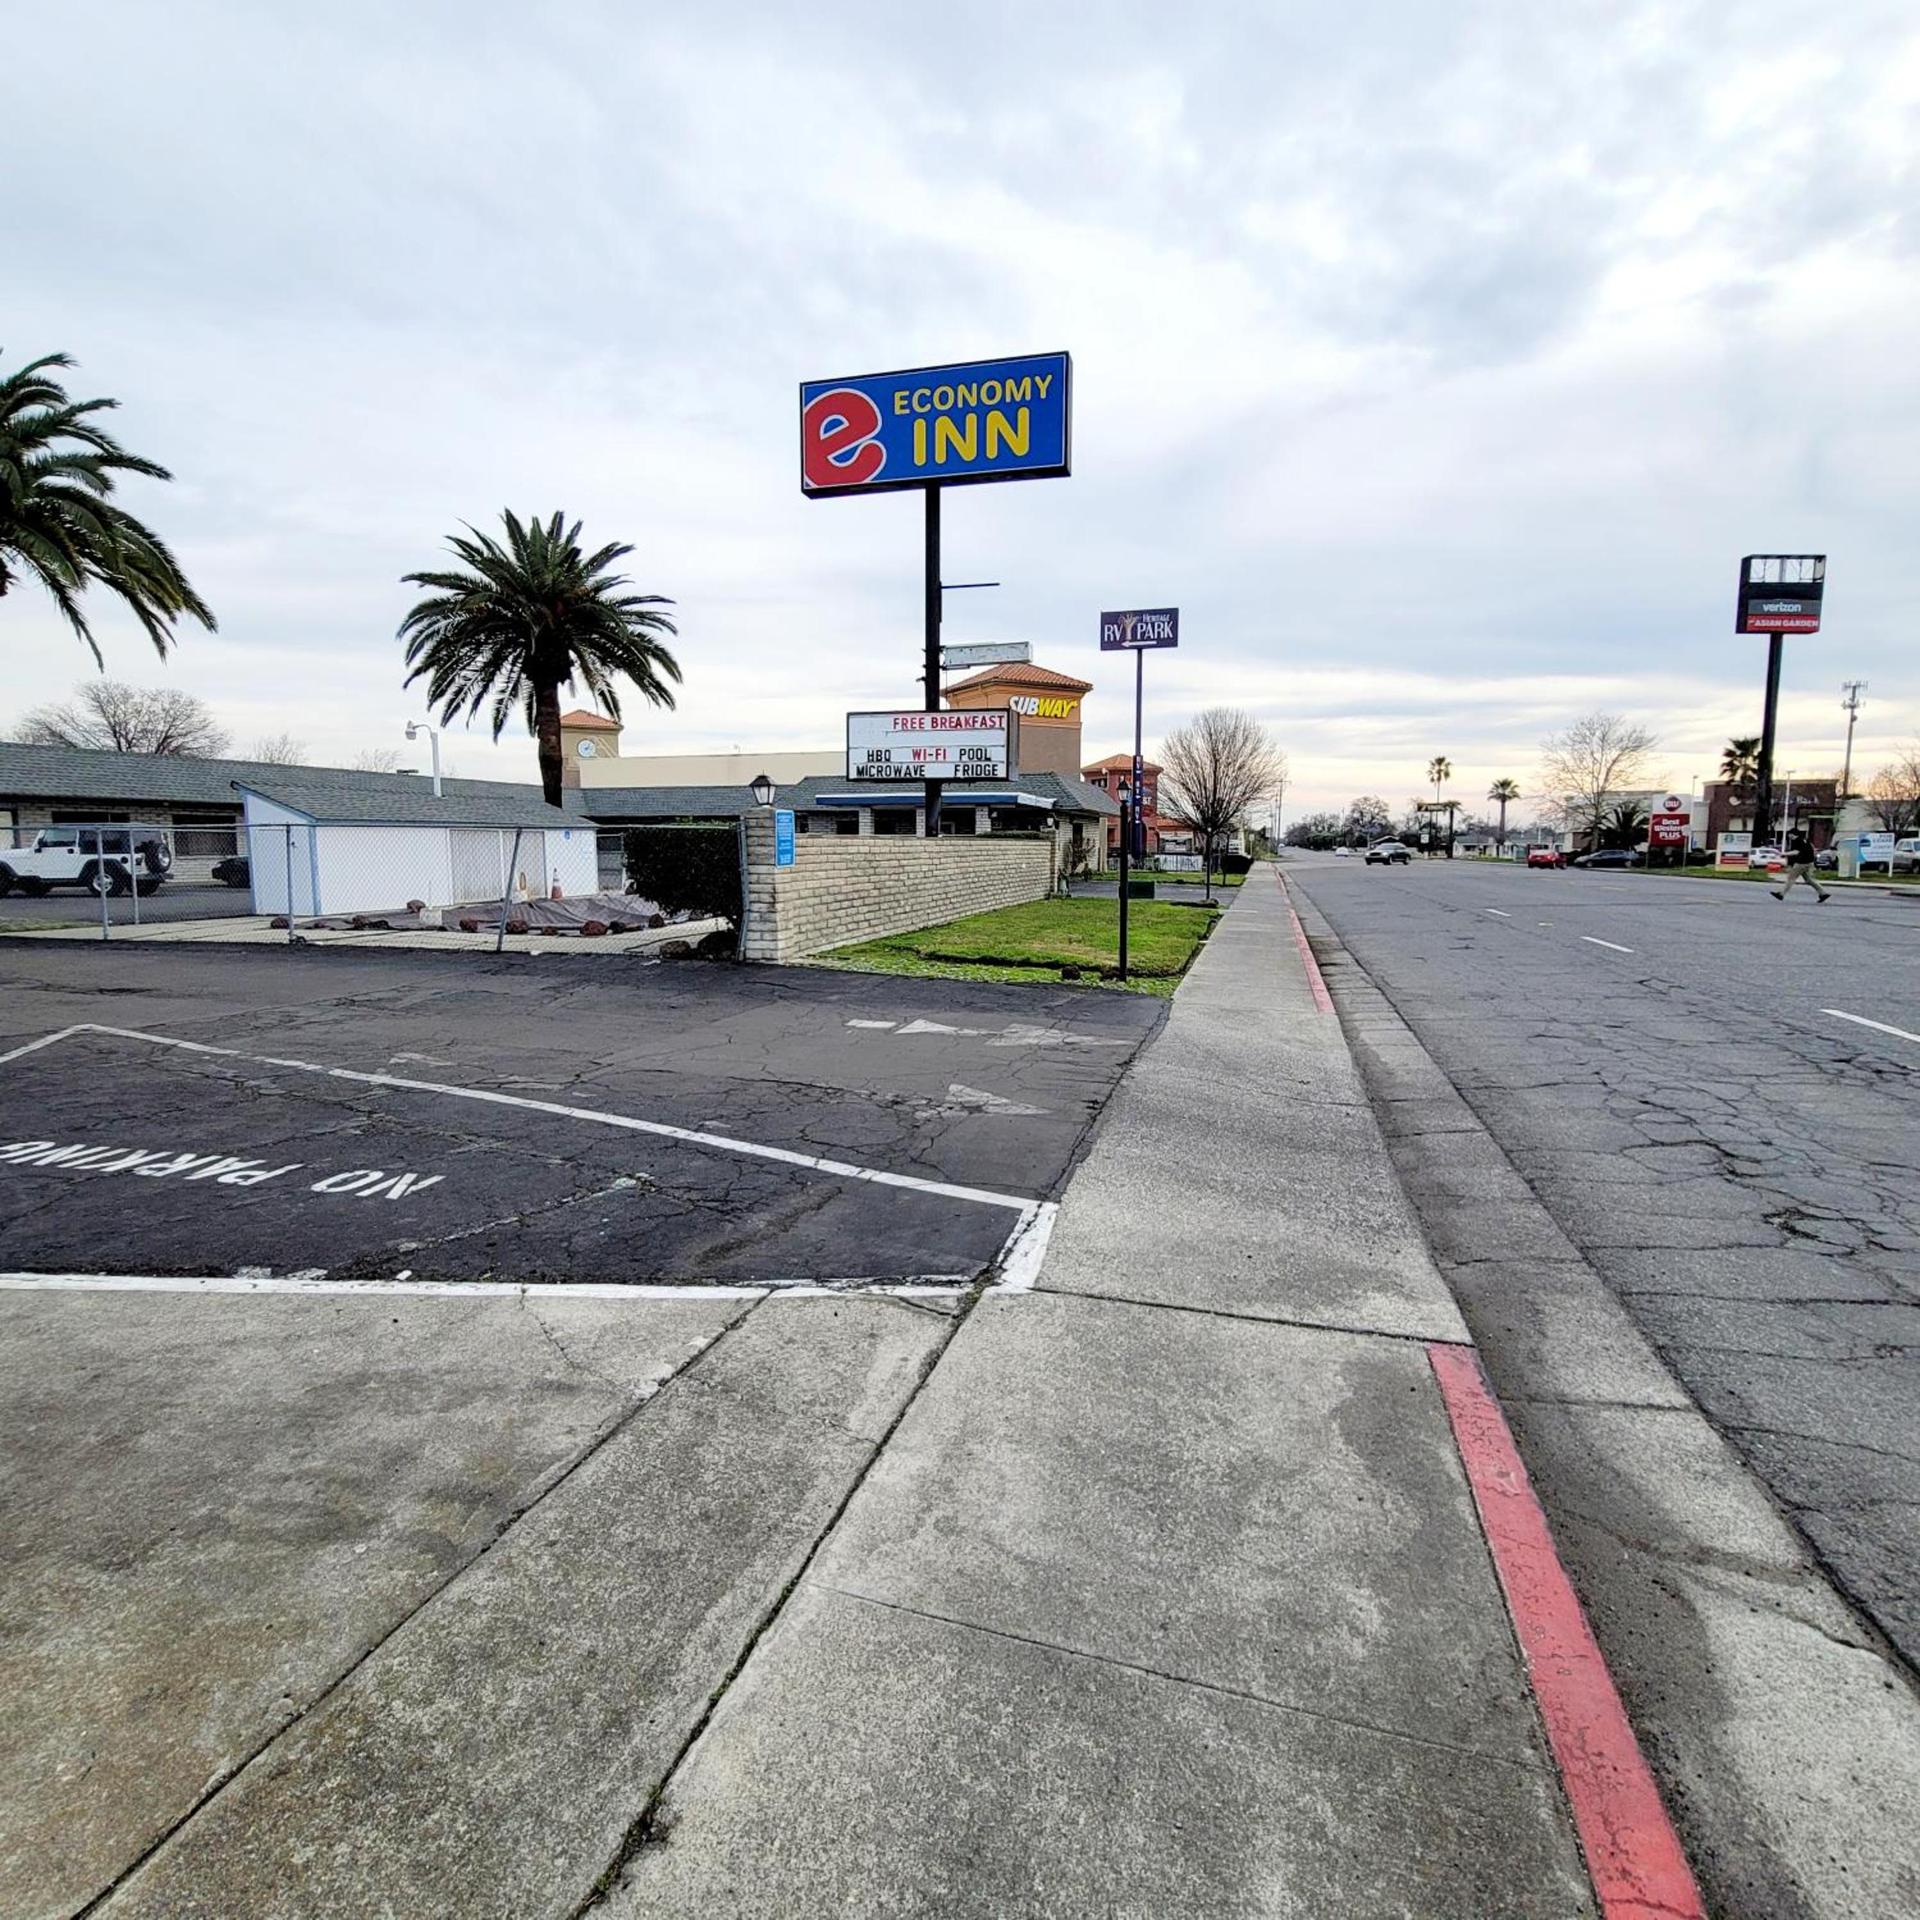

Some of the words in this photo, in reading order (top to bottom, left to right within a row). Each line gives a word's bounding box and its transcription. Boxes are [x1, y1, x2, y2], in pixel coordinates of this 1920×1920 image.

[894, 374, 1053, 415] ECONOMY
[913, 406, 1030, 467] INN
[1762, 602, 1801, 612] verizon
[1104, 624, 1123, 642] RV
[1137, 621, 1174, 640] PARK
[1009, 695, 1078, 718] SUBWAY
[893, 717, 925, 730] FREE
[931, 715, 1005, 729] BREAKFAST
[911, 748, 947, 761] WI-FI
[959, 748, 992, 761] POOL
[856, 764, 926, 777] MICROWAVE
[954, 764, 998, 776] FRIDGE
[310, 1169, 447, 1200] NO
